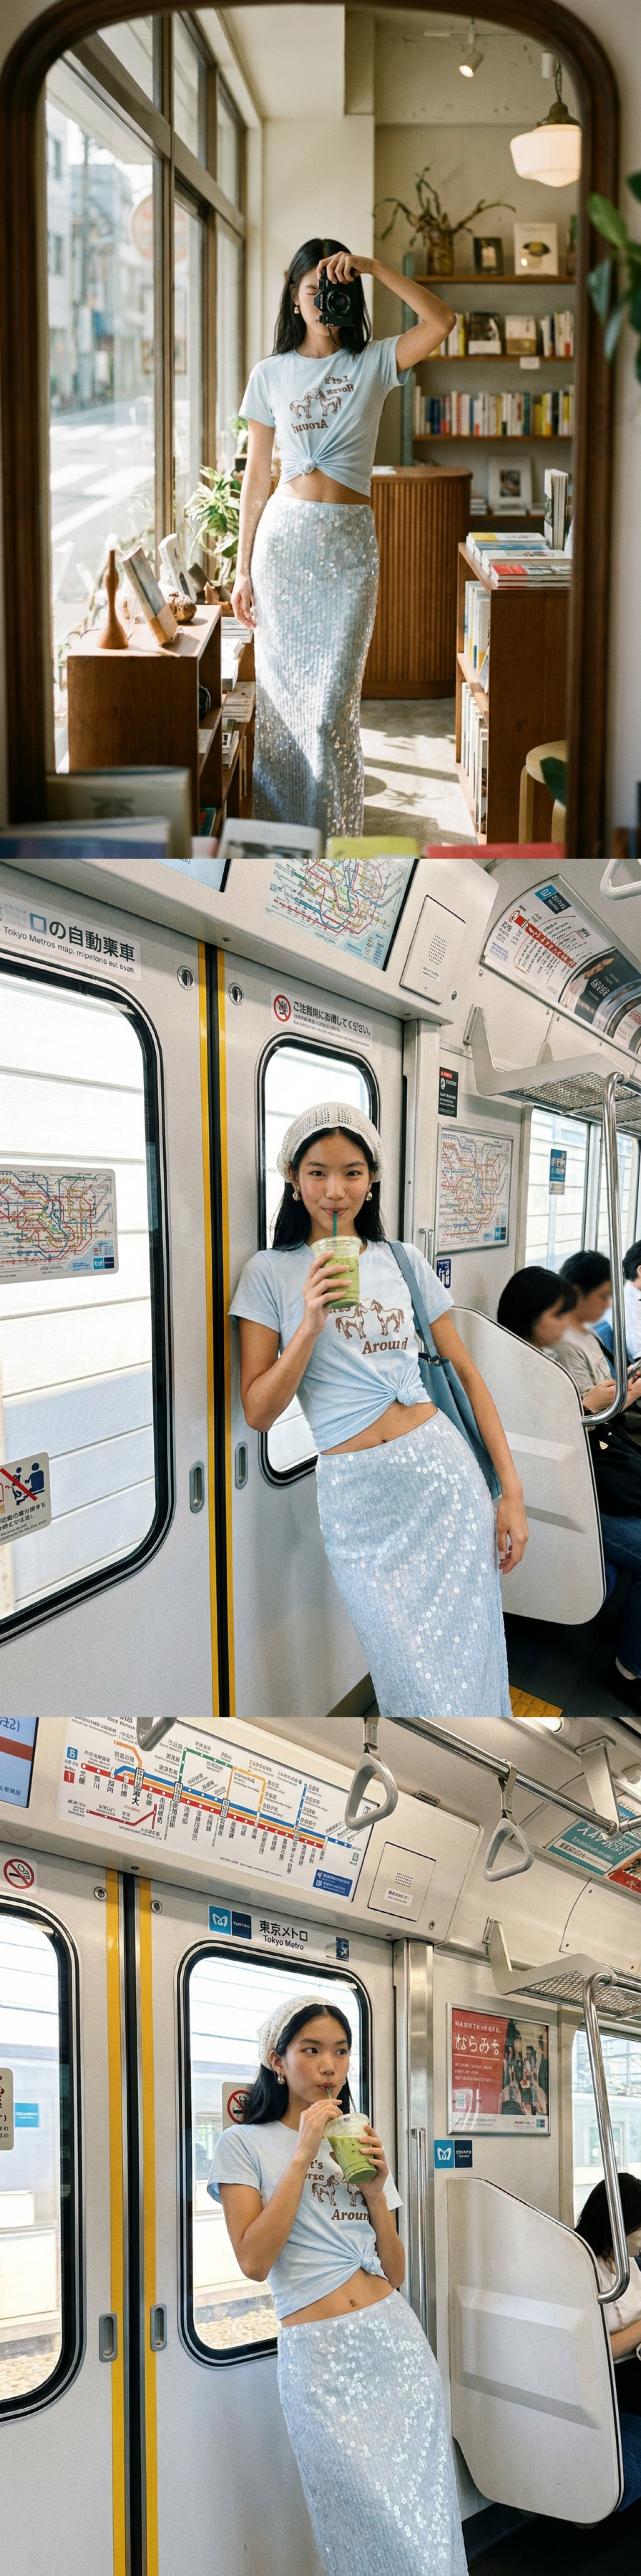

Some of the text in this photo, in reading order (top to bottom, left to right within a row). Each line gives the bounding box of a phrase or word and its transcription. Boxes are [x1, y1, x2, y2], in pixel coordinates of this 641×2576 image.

[4, 926, 27, 939] Tokyo
[30, 934, 56, 948] Metros
[58, 944, 75, 954] map.
[259, 1920, 308, 1942] 東京メトロ
[263, 1934, 304, 1950] Tokyo Metro
[310, 2160, 324, 2169] t's
[331, 2208, 370, 2221] Aroun
